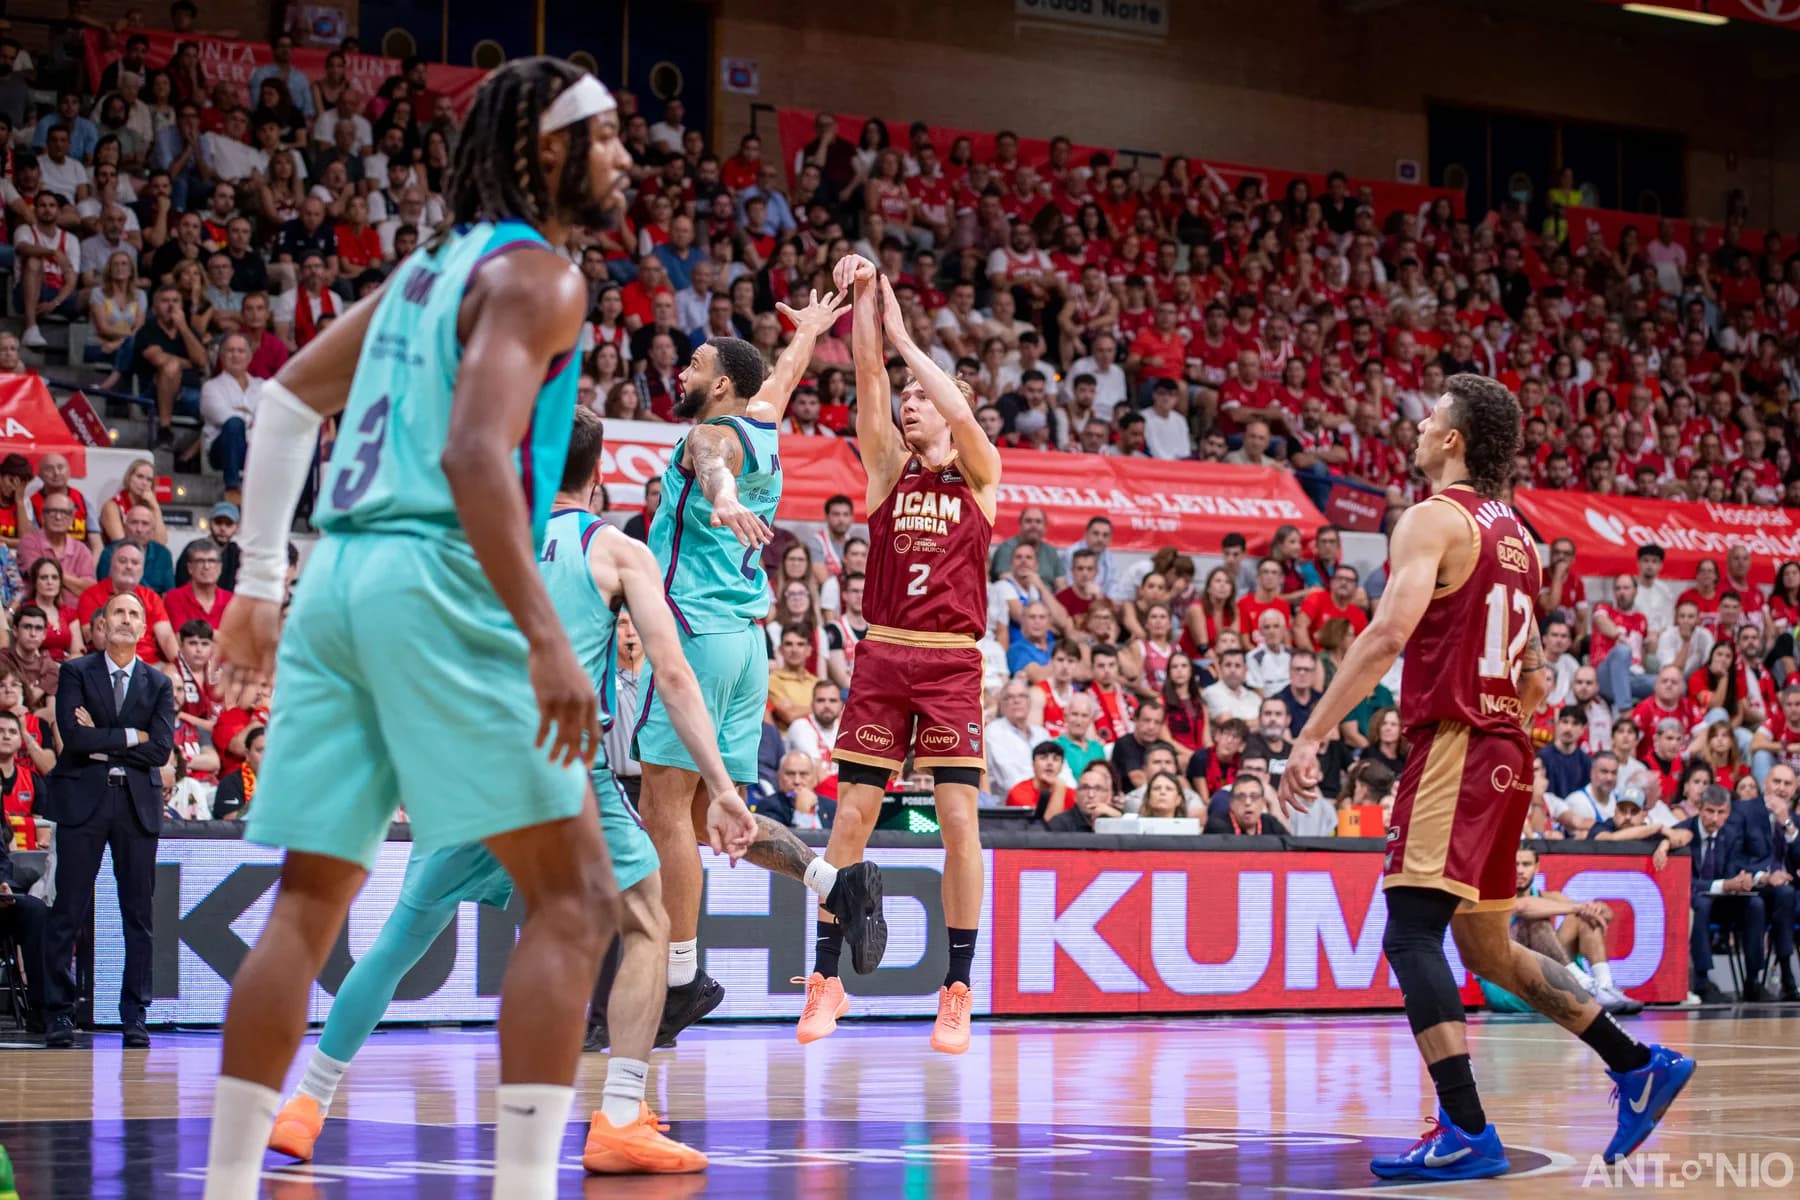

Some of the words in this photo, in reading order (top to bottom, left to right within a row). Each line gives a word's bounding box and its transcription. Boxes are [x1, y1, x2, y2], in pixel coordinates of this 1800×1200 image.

[331, 394, 390, 511] 3
[996, 483, 1136, 509] STRELLA
[1152, 492, 1302, 519] LEVANTE
[894, 516, 948, 537] MURCIA
[907, 563, 931, 596] 2
[859, 730, 891, 746] Juver
[923, 732, 956, 745] Juver
[1017, 868, 1666, 997] KUMO
